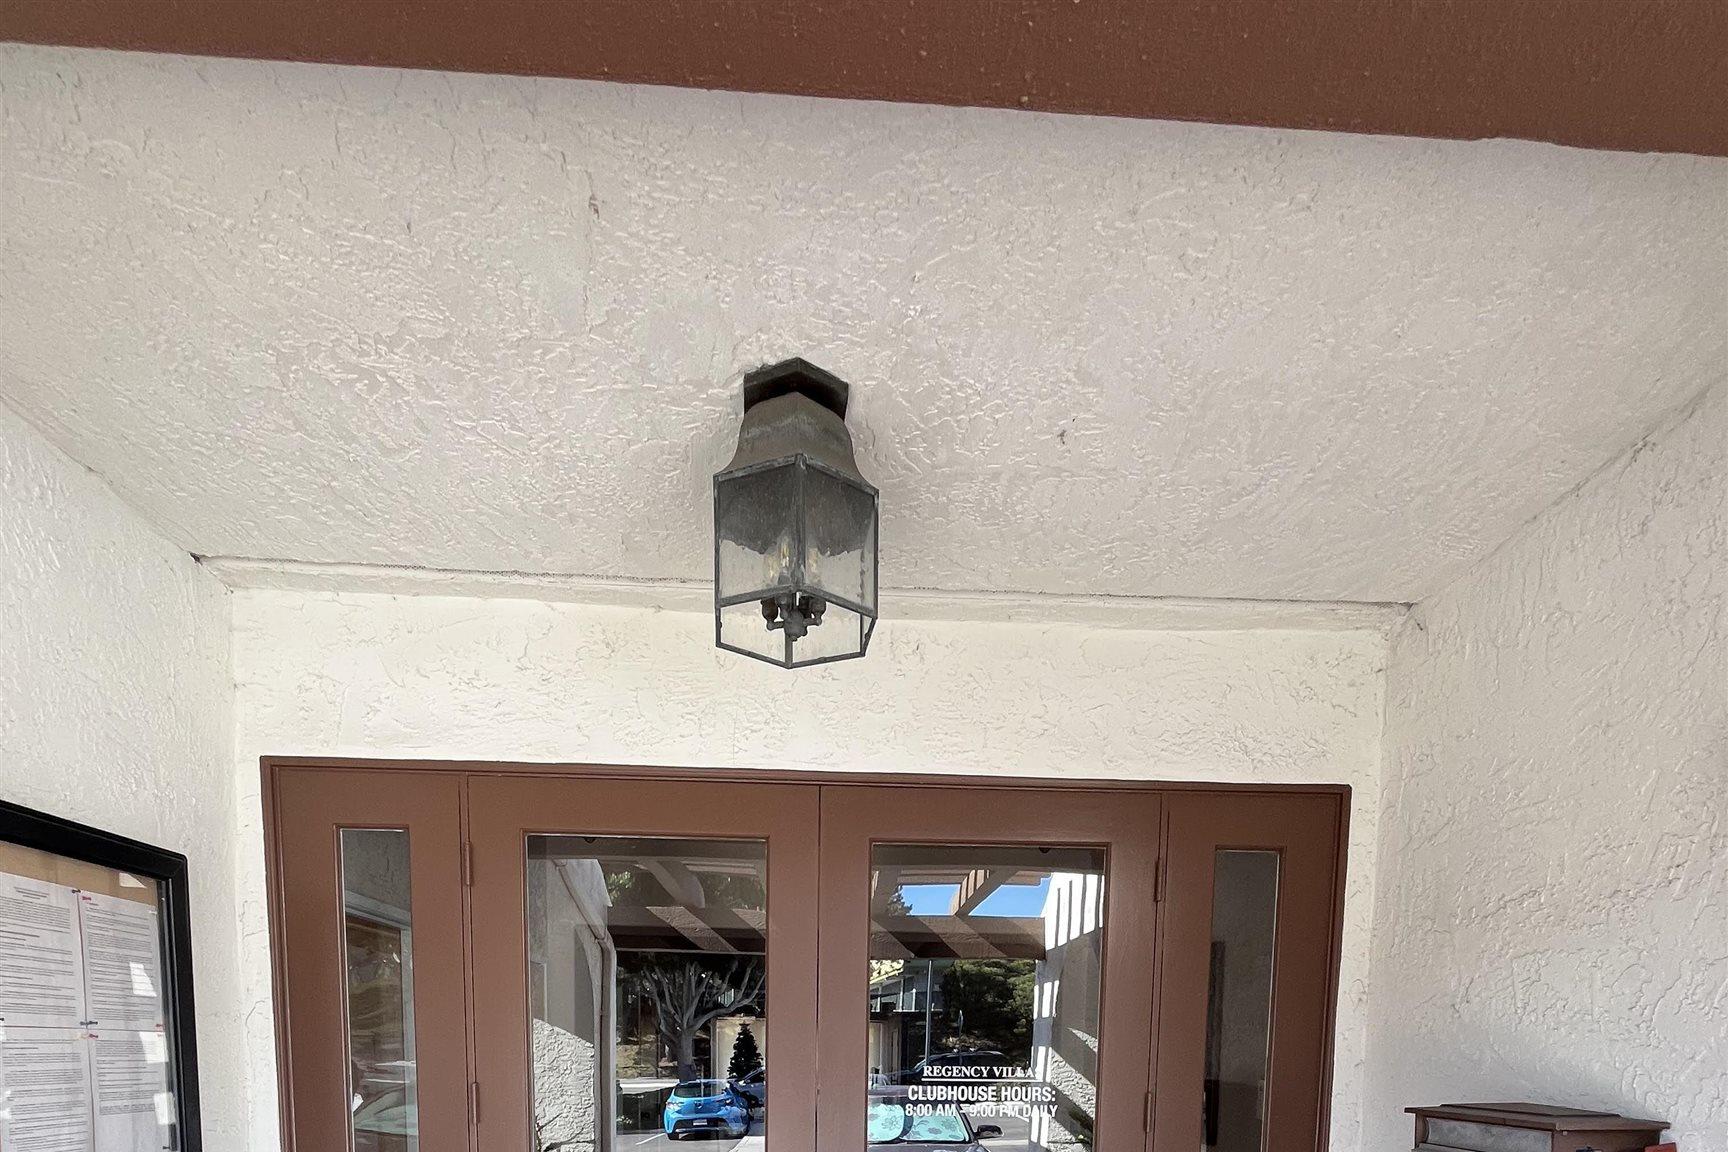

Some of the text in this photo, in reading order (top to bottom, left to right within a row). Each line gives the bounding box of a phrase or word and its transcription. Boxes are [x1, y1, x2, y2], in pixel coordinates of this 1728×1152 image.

[923, 1066, 991, 1078] REGENCY
[908, 1085, 1056, 1101] CLUBHOUSE HOURS:
[905, 1103, 932, 1117] 8:00
[935, 1104, 956, 1117] AM
[969, 1104, 996, 1117] 9:00
[1000, 1105, 1019, 1117] PM
[1022, 1104, 1058, 1117] DAILY
